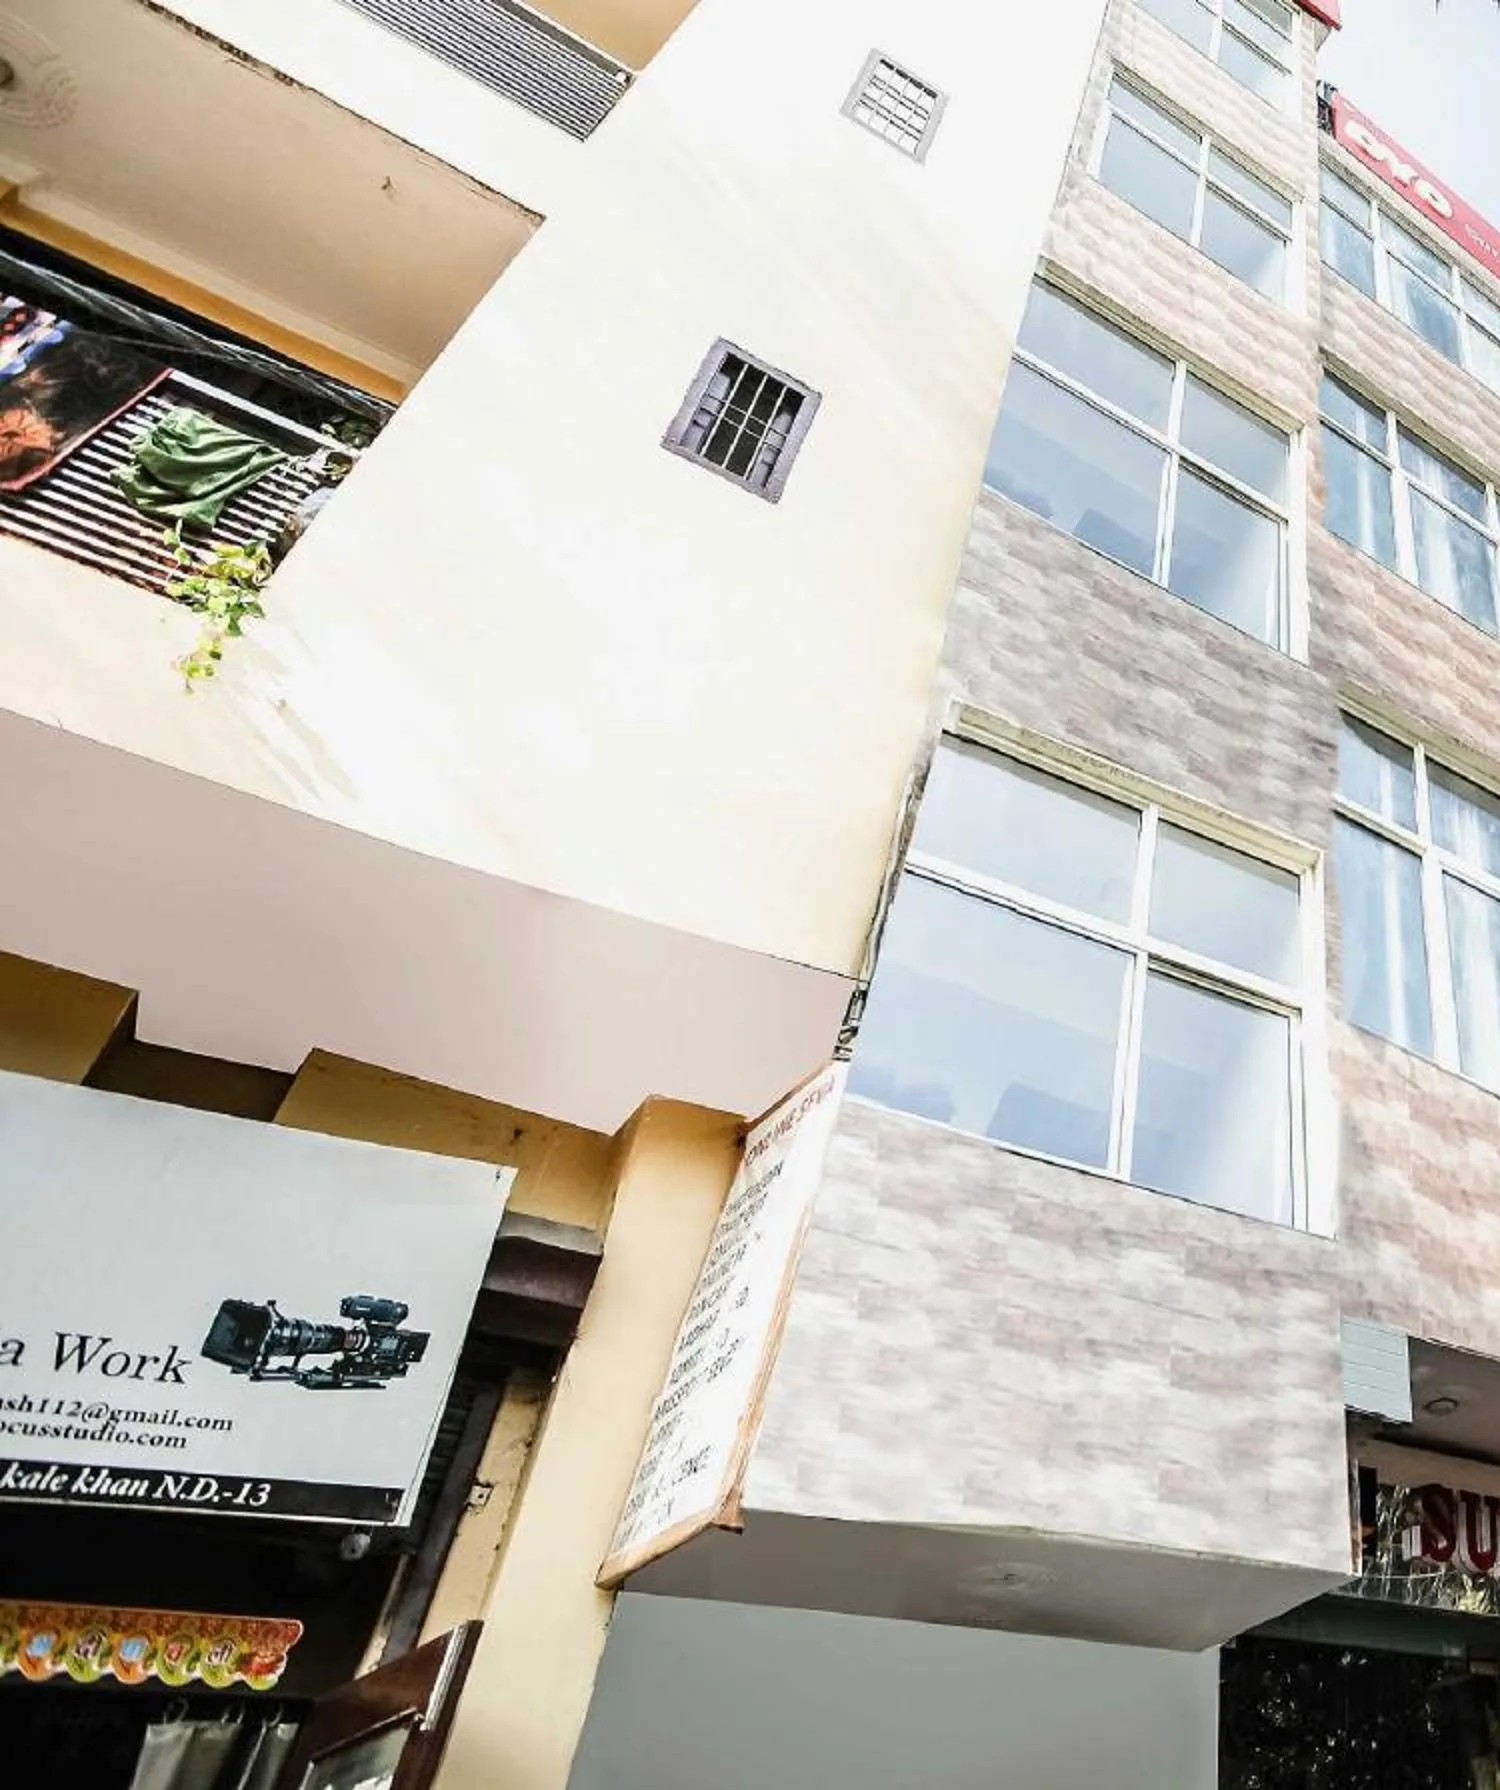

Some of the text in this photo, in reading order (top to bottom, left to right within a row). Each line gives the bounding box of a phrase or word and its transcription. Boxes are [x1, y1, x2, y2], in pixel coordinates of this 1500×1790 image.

[1344, 119, 1454, 219] OYO
[53, 1331, 193, 1384] Work
[0, 1461, 272, 1507] kale khan N.D.-13
